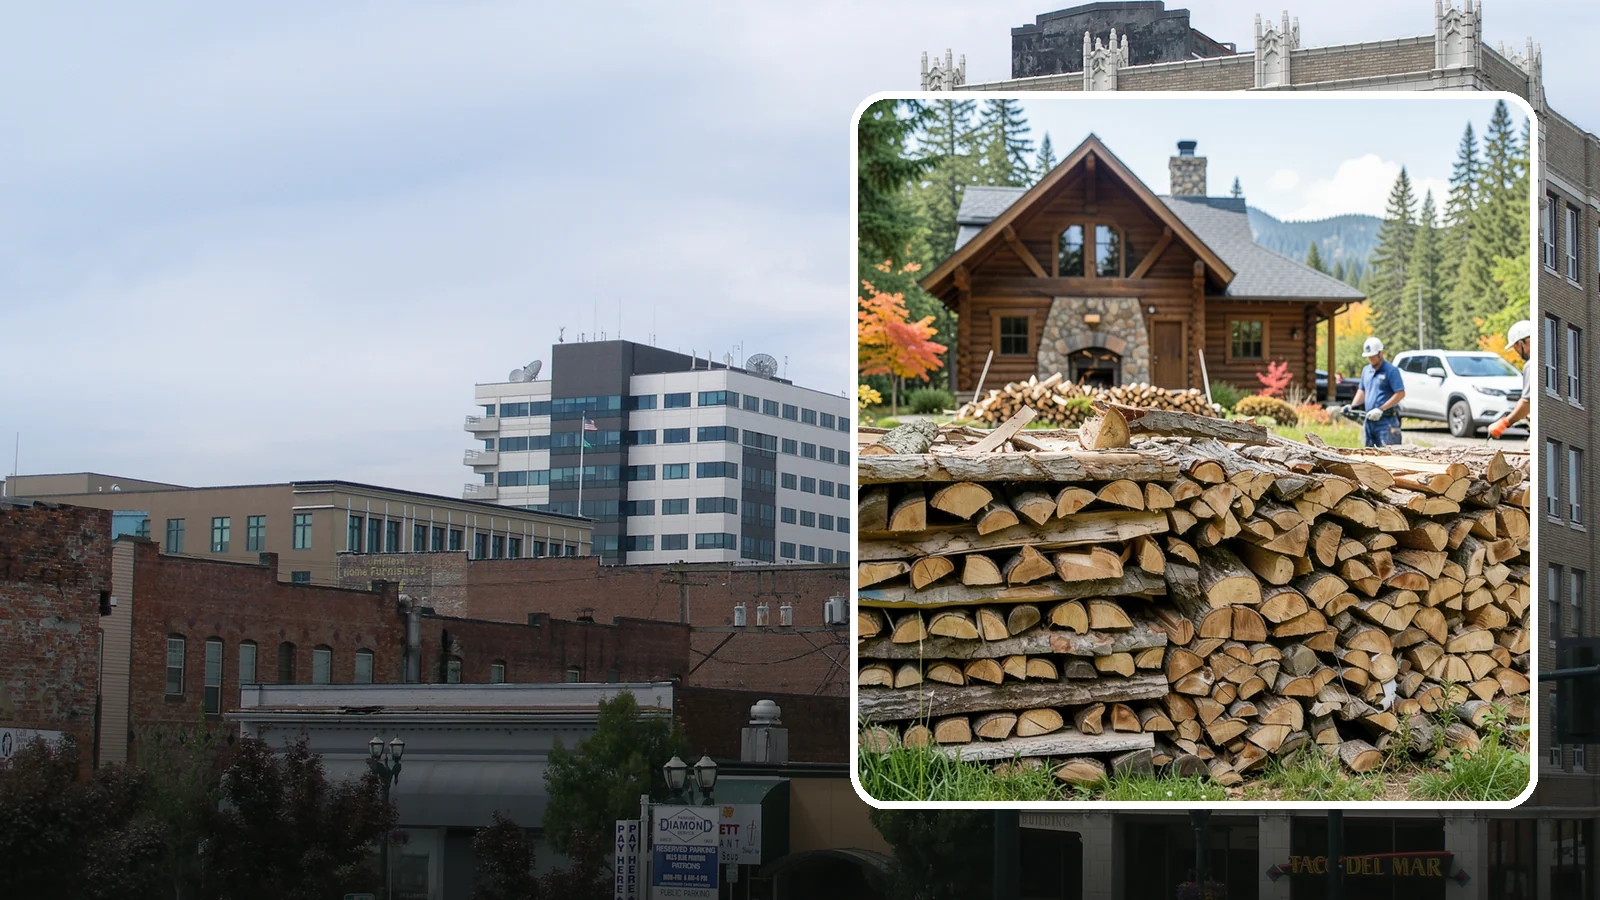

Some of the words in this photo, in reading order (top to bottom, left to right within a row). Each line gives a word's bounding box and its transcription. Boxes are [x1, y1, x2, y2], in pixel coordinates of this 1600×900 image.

[343, 568, 368, 577] Home
[370, 566, 427, 577] Furnishers
[660, 818, 713, 832] DIAMOND
[1022, 815, 1070, 828] BUILDING
[617, 825, 625, 852] PAY
[628, 824, 636, 852] PAY
[656, 845, 688, 853] RESERVED
[689, 846, 716, 854] PARKING
[721, 851, 739, 862] Soup
[671, 862, 701, 870] PATRONS
[1289, 856, 1332, 874] TAC
[1345, 856, 1385, 875] DEL
[1392, 857, 1443, 877] MAR
[616, 856, 625, 894] HERE
[627, 855, 636, 894] HERE
[660, 888, 682, 897] PUBLIC
[683, 889, 710, 898] PARKING
